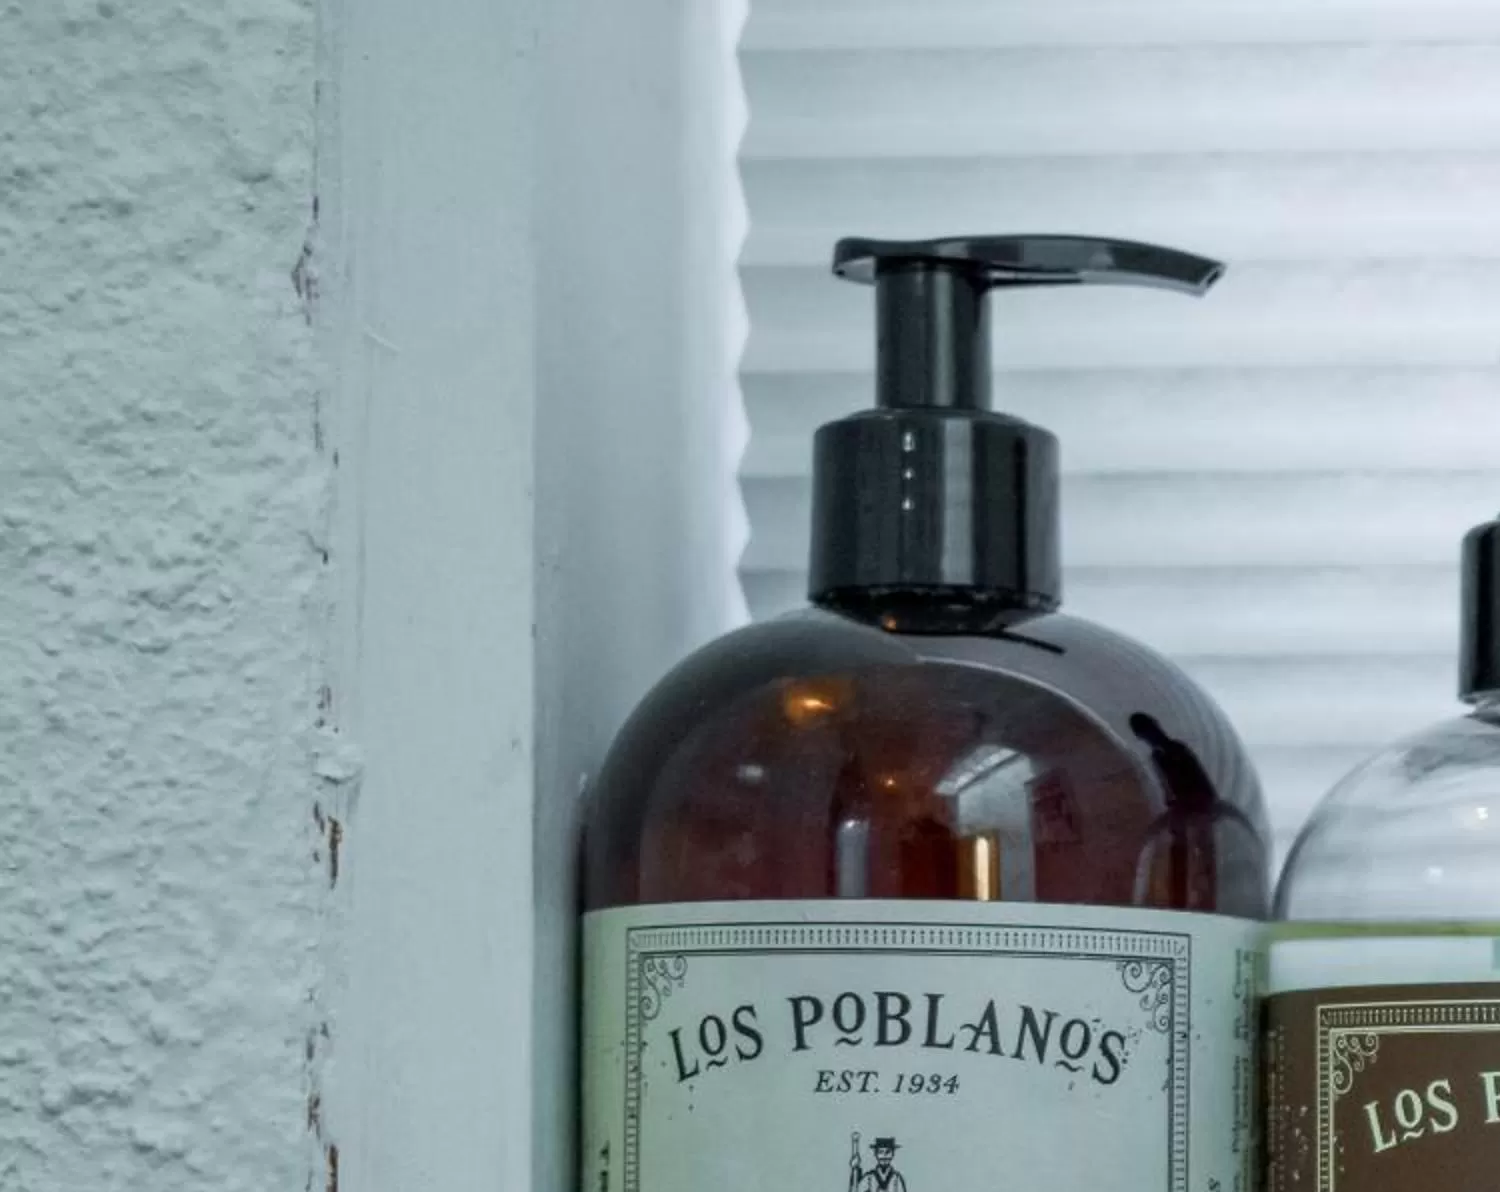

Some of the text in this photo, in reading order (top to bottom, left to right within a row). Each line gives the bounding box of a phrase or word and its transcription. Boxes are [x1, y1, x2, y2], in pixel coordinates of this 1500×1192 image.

[668, 990, 1127, 1086] LOS POBLANOS
[815, 1069, 960, 1096] EST. 1934
[1364, 1079, 1459, 1153] LOS
